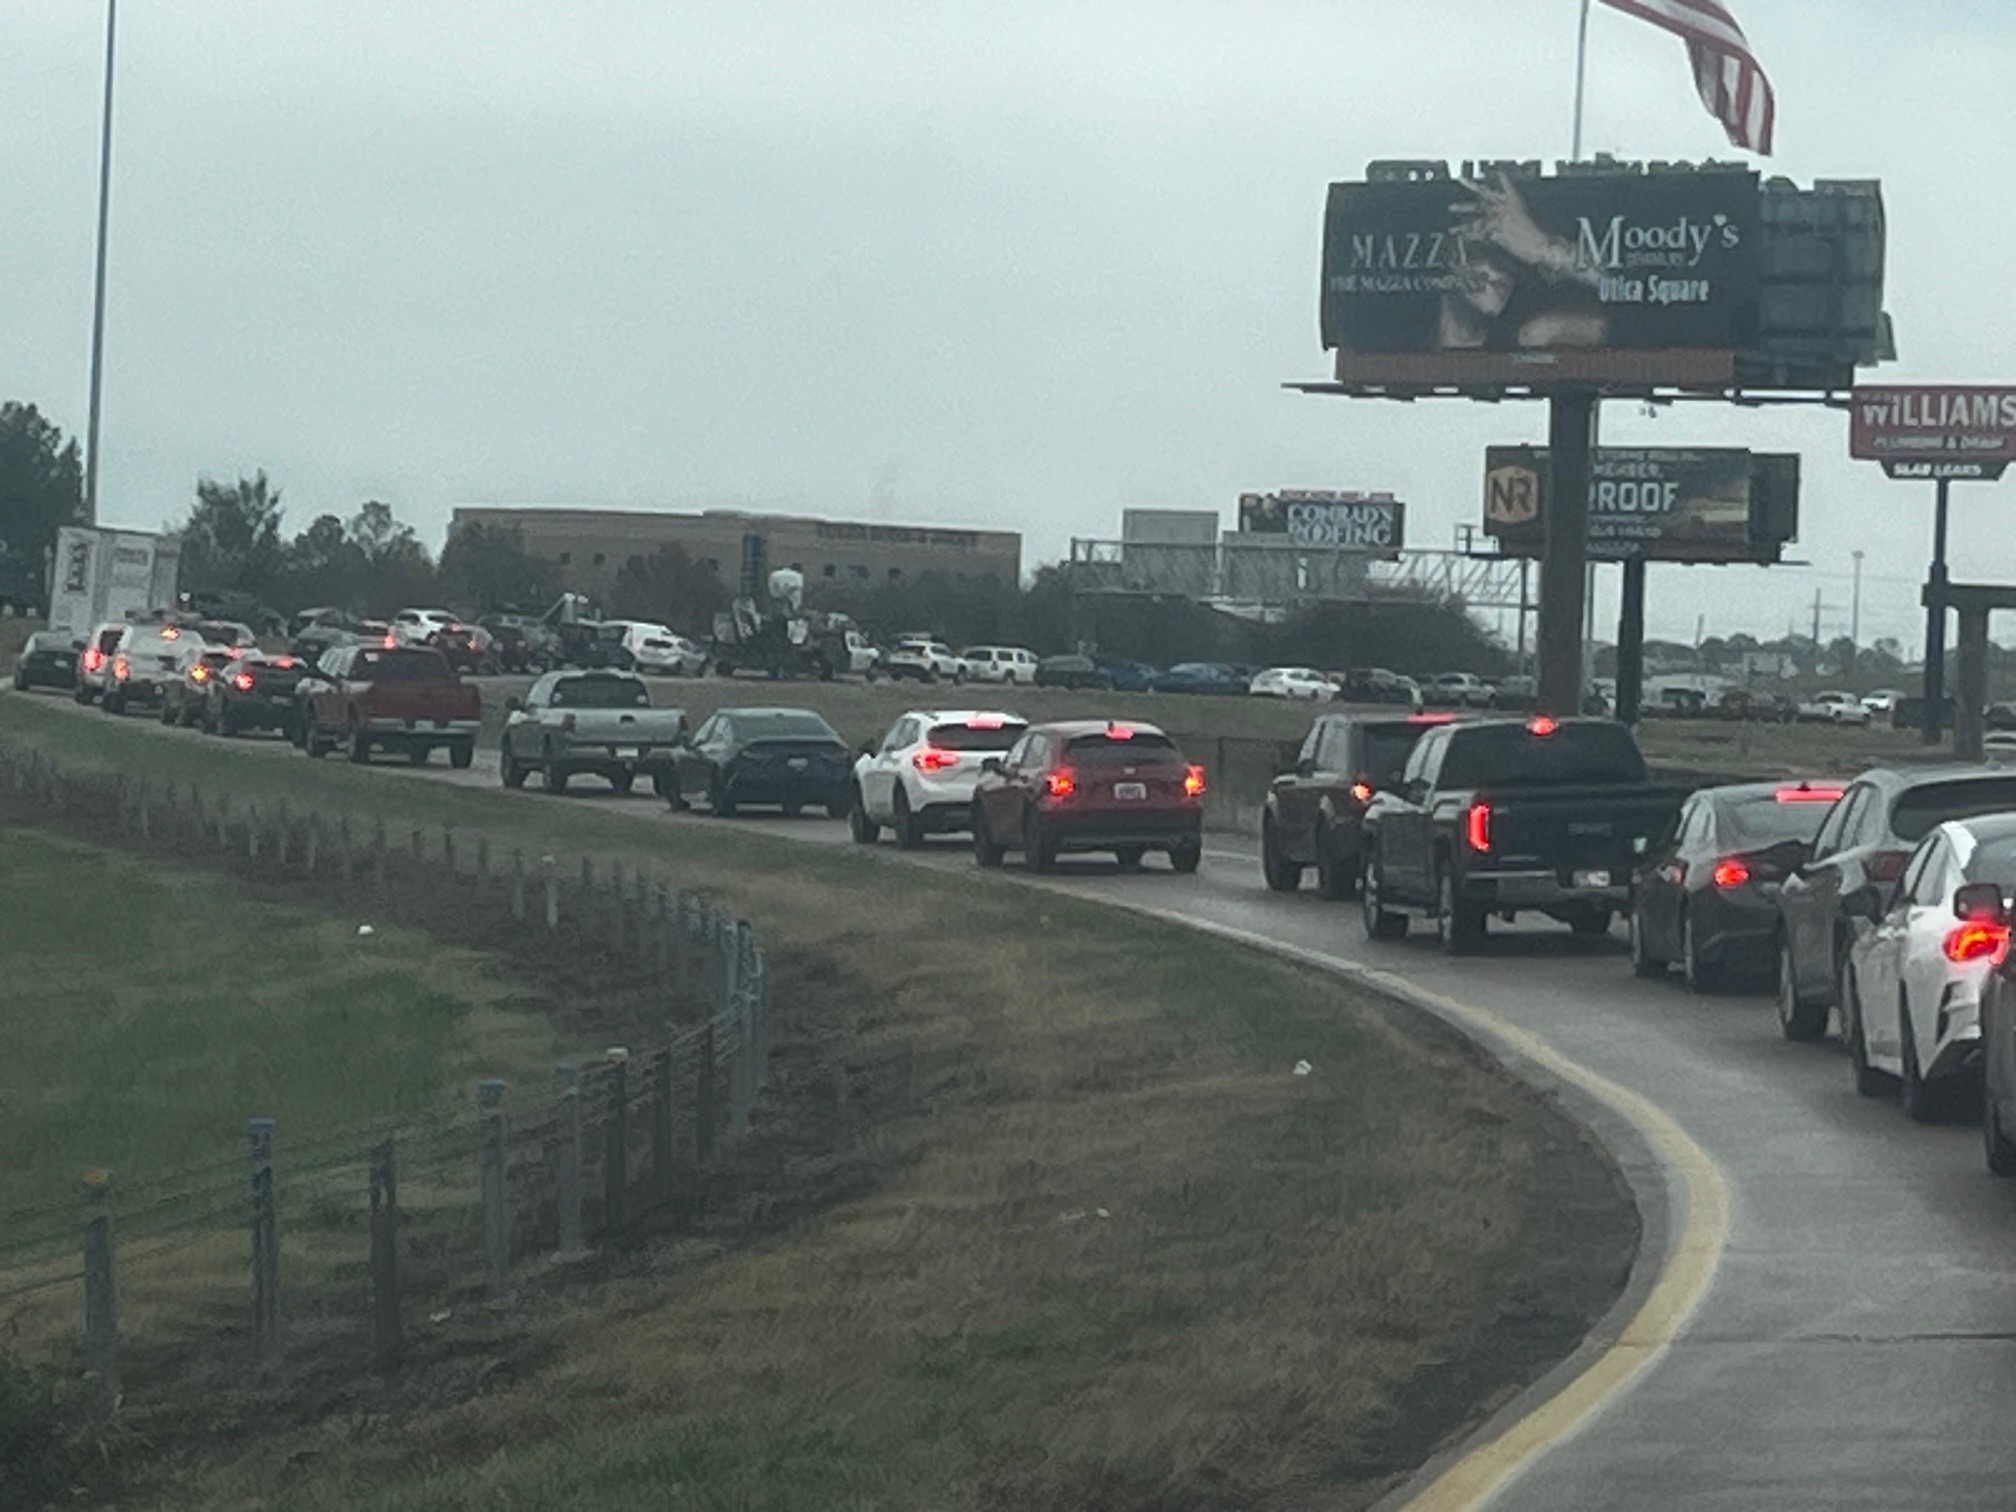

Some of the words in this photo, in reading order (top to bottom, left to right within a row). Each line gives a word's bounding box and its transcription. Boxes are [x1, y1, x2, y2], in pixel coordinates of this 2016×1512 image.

[1575, 213, 1740, 268] Moody's
[1648, 274, 1710, 306] Square
[1862, 394, 2016, 428] WILLIAMS
[1490, 477, 1532, 514] NR
